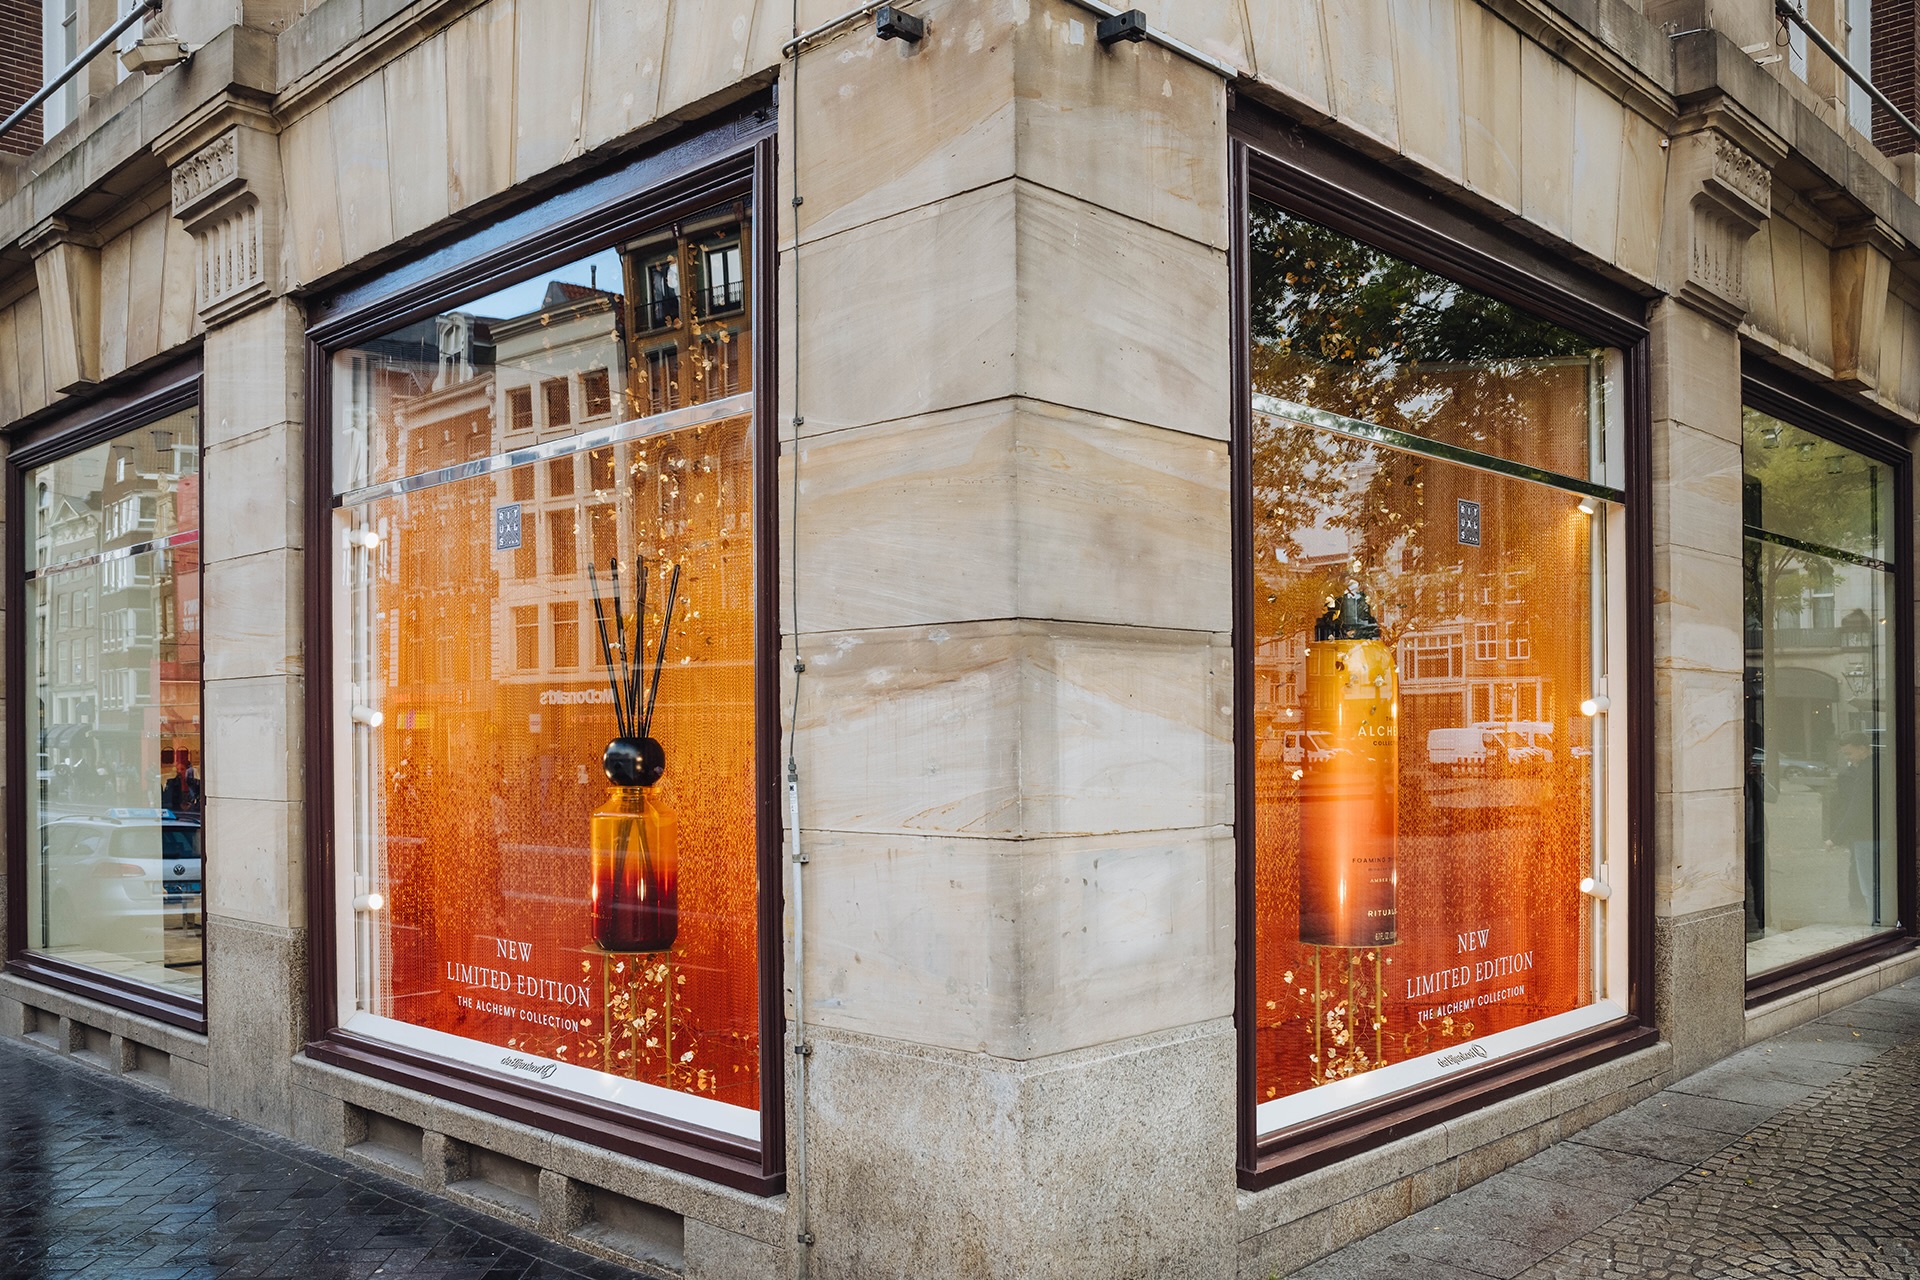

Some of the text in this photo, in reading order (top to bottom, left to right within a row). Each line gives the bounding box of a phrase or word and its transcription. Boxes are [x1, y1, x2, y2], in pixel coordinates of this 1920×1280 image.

[496, 938, 532, 963] NEW
[1457, 928, 1490, 954] NEW
[446, 961, 591, 1008] LIMITED EDITION
[1406, 950, 1534, 1000] LIMITED EDITION
[457, 995, 579, 1033] THE ALCHEMY COLLECTION
[1418, 984, 1525, 1023] THE ALCHEMY COLLECTION
